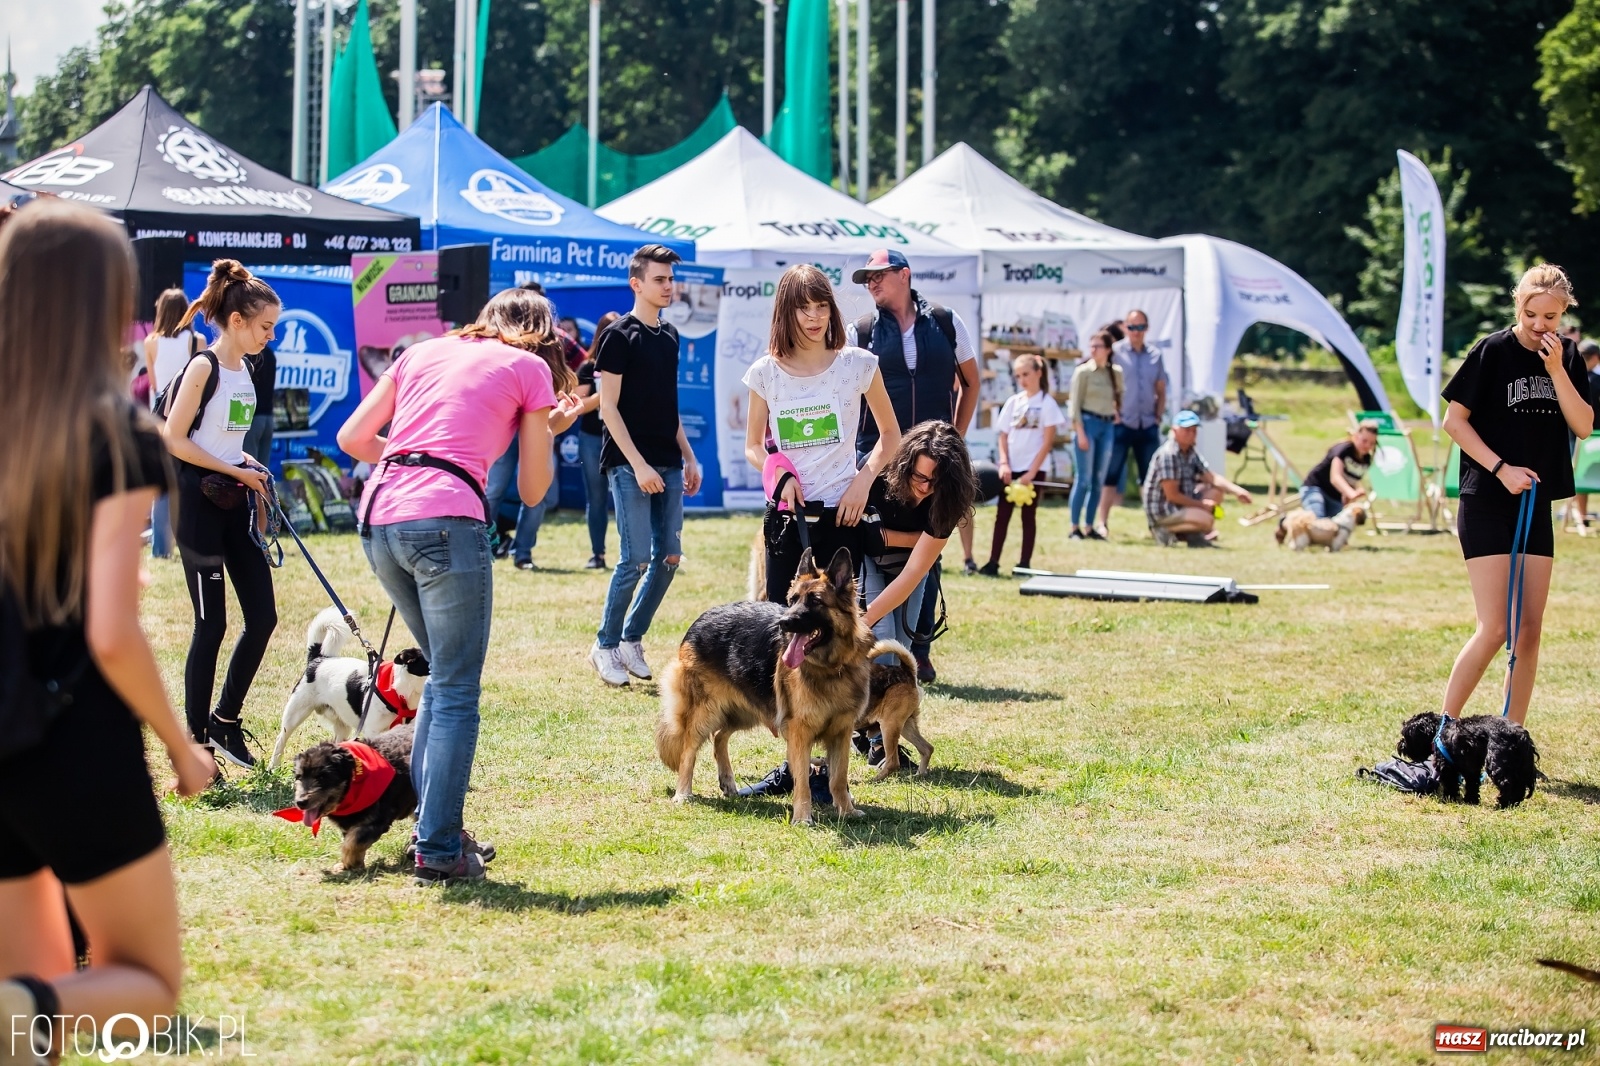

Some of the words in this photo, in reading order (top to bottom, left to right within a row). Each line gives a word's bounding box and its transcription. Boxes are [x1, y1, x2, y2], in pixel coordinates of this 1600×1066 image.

[198, 231, 282, 248] KONFERANSJER
[293, 233, 307, 249] DJ
[324, 235, 345, 249] +48
[347, 236, 368, 250] 607
[759, 218, 909, 244] TropiDog
[492, 237, 562, 265] Farmina
[567, 242, 593, 267] Pet
[1002, 264, 1063, 283] TropiDog
[1508, 378, 1529, 407] LOS
[1530, 376, 1558, 401] ANGE
[244, 408, 251, 421] 8
[780, 404, 831, 416] DOGTREKKING
[803, 423, 814, 437] 6
